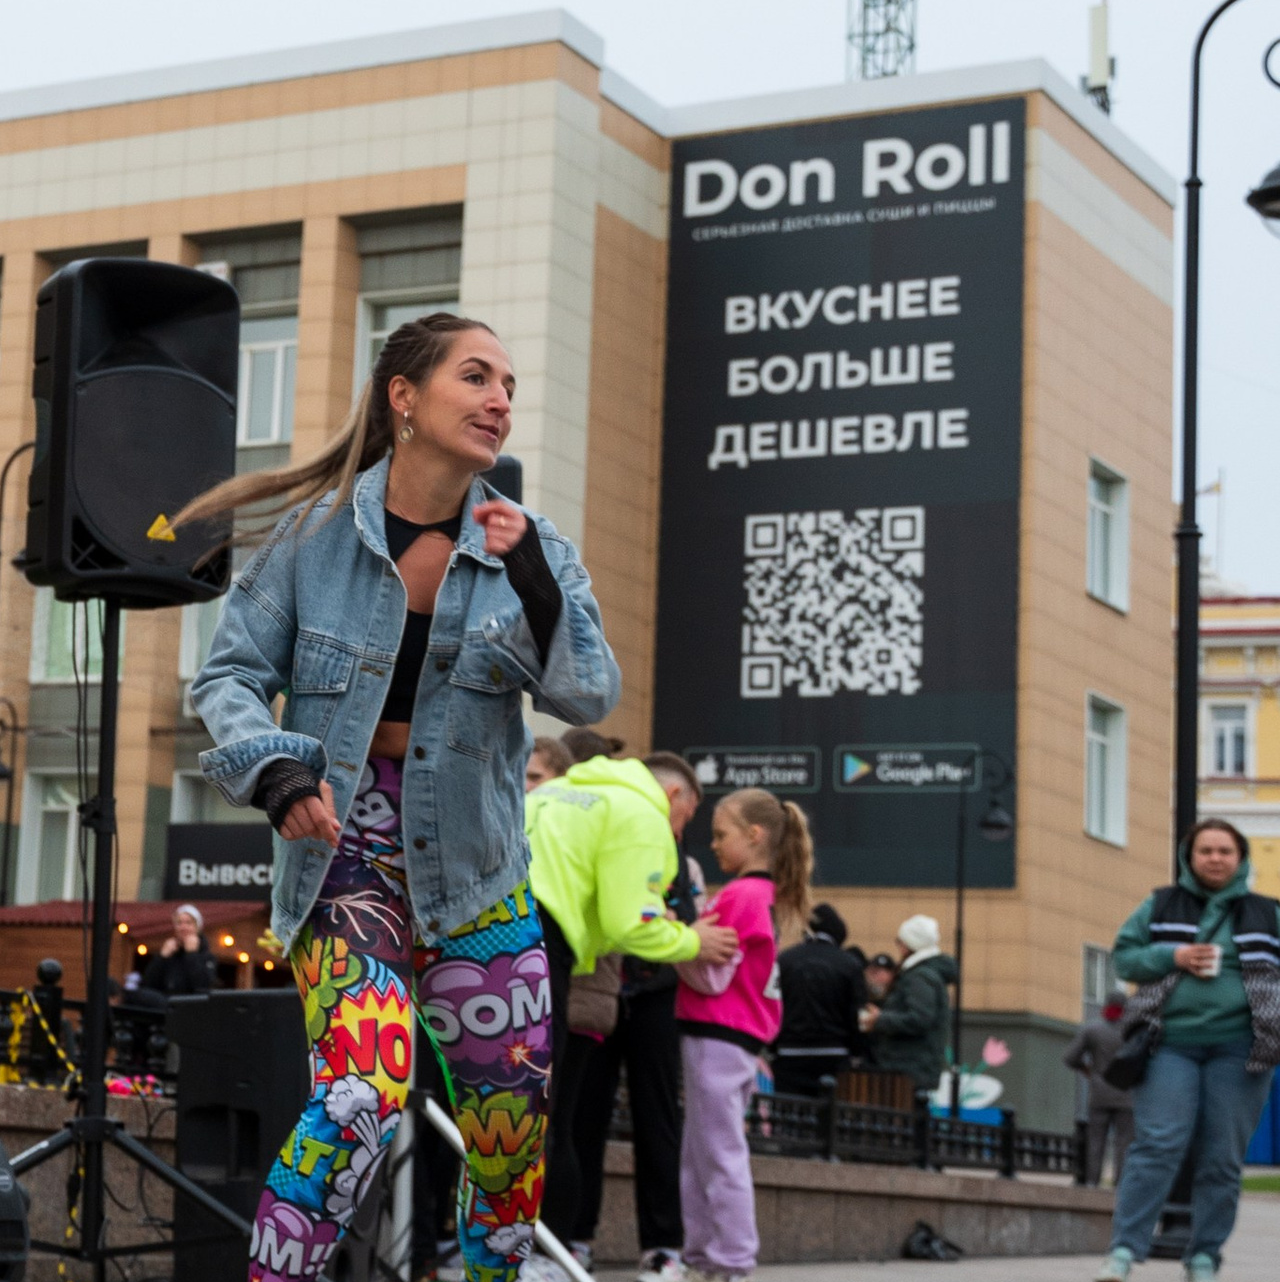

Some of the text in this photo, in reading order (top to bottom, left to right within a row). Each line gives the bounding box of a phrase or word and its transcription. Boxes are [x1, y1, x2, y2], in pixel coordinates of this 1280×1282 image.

[682, 120, 1011, 218] Don Roll
[780, 210, 865, 233] ДОСТАВКА
[866, 205, 915, 223] СУШИ
[724, 275, 961, 335] ВКУСНЕЕ
[727, 342, 955, 398] БОЛЬШЕ
[708, 407, 969, 470] ДЕШЕВЛЕ
[723, 765, 809, 788] App Store
[876, 764, 934, 786] Google
[178, 857, 274, 887] Вывес
